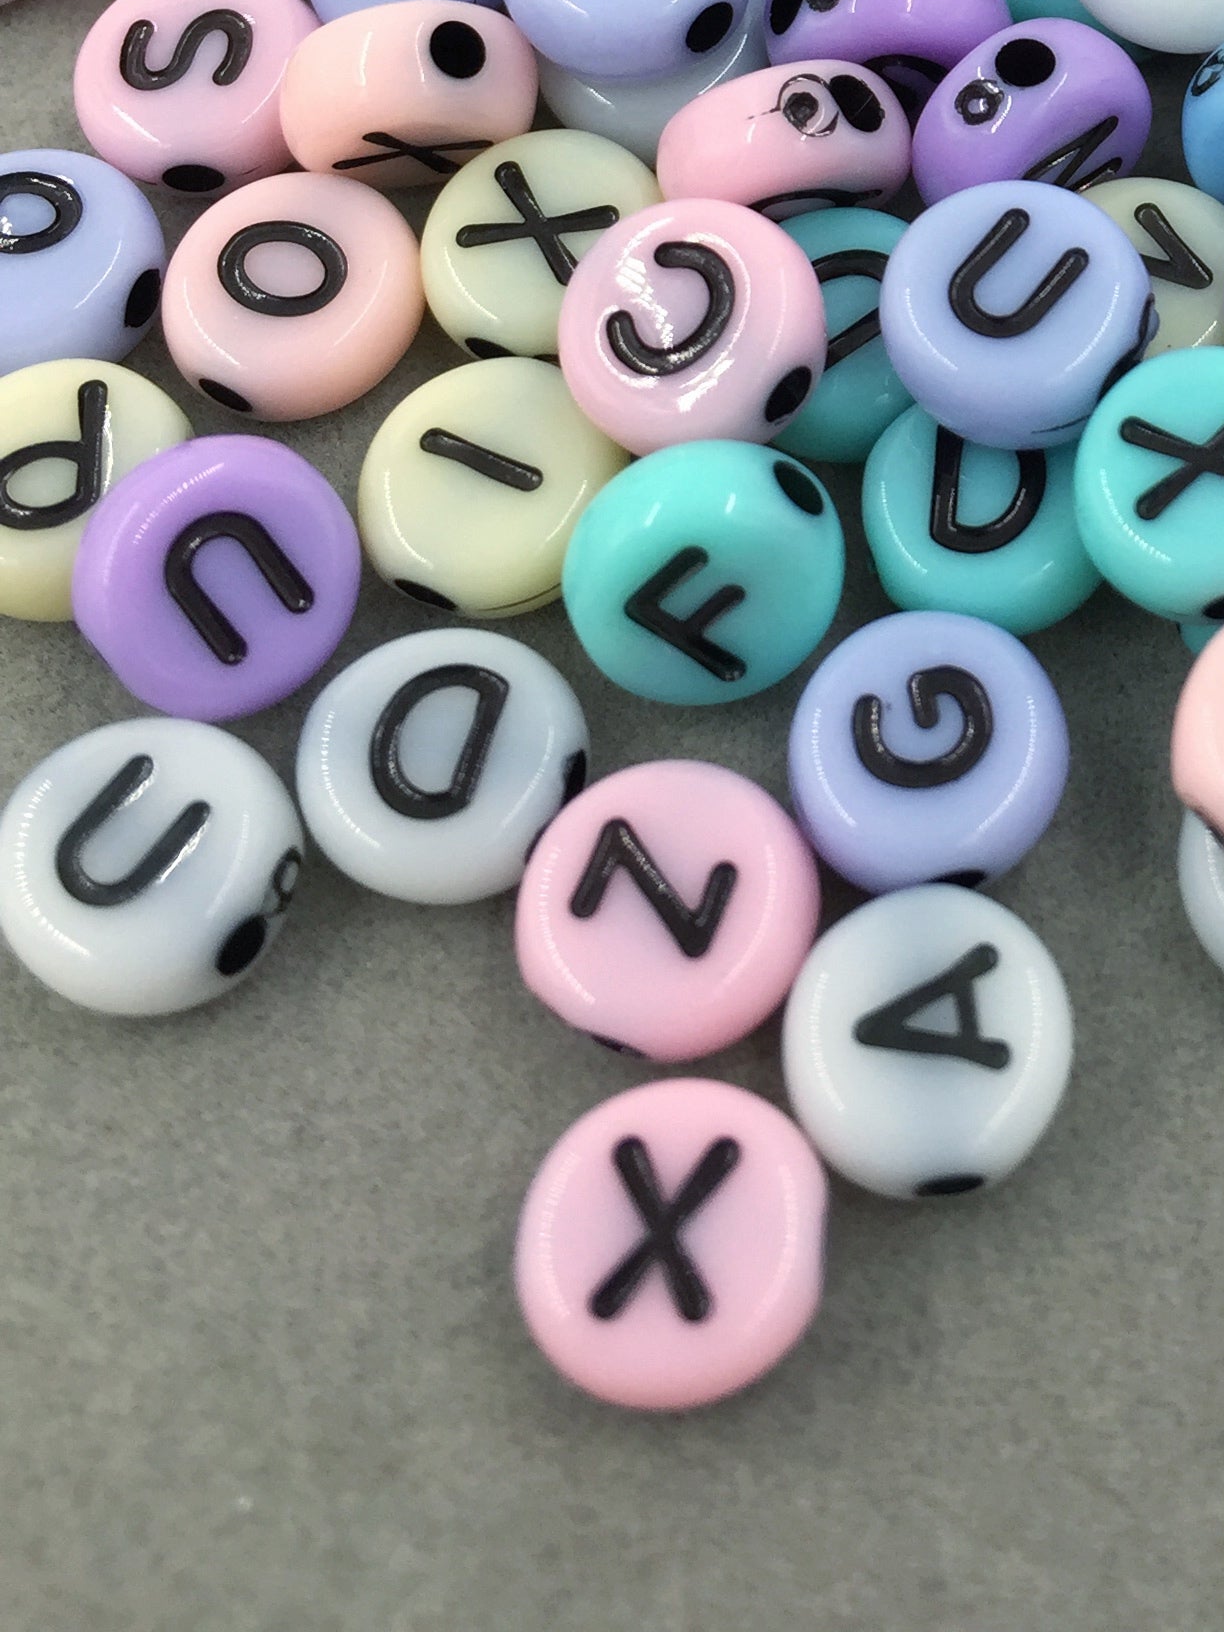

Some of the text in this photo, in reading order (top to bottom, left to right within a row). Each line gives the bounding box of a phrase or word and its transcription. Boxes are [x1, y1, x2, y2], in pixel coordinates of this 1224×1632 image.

[118, 8, 254, 92] S
[217, 220, 348, 318] O
[455, 160, 620, 286] X
[948, 208, 1090, 340] U
[606, 240, 736, 377] C
[0, 378, 109, 531] P
[419, 426, 544, 492] I
[164, 510, 315, 666] U
[623, 545, 749, 682] F
[368, 663, 510, 820] D
[852, 664, 994, 789] G
[55, 753, 211, 909] U
[570, 817, 739, 959] Z
[855, 942, 1011, 1071] A
[587, 1133, 743, 1323] X
